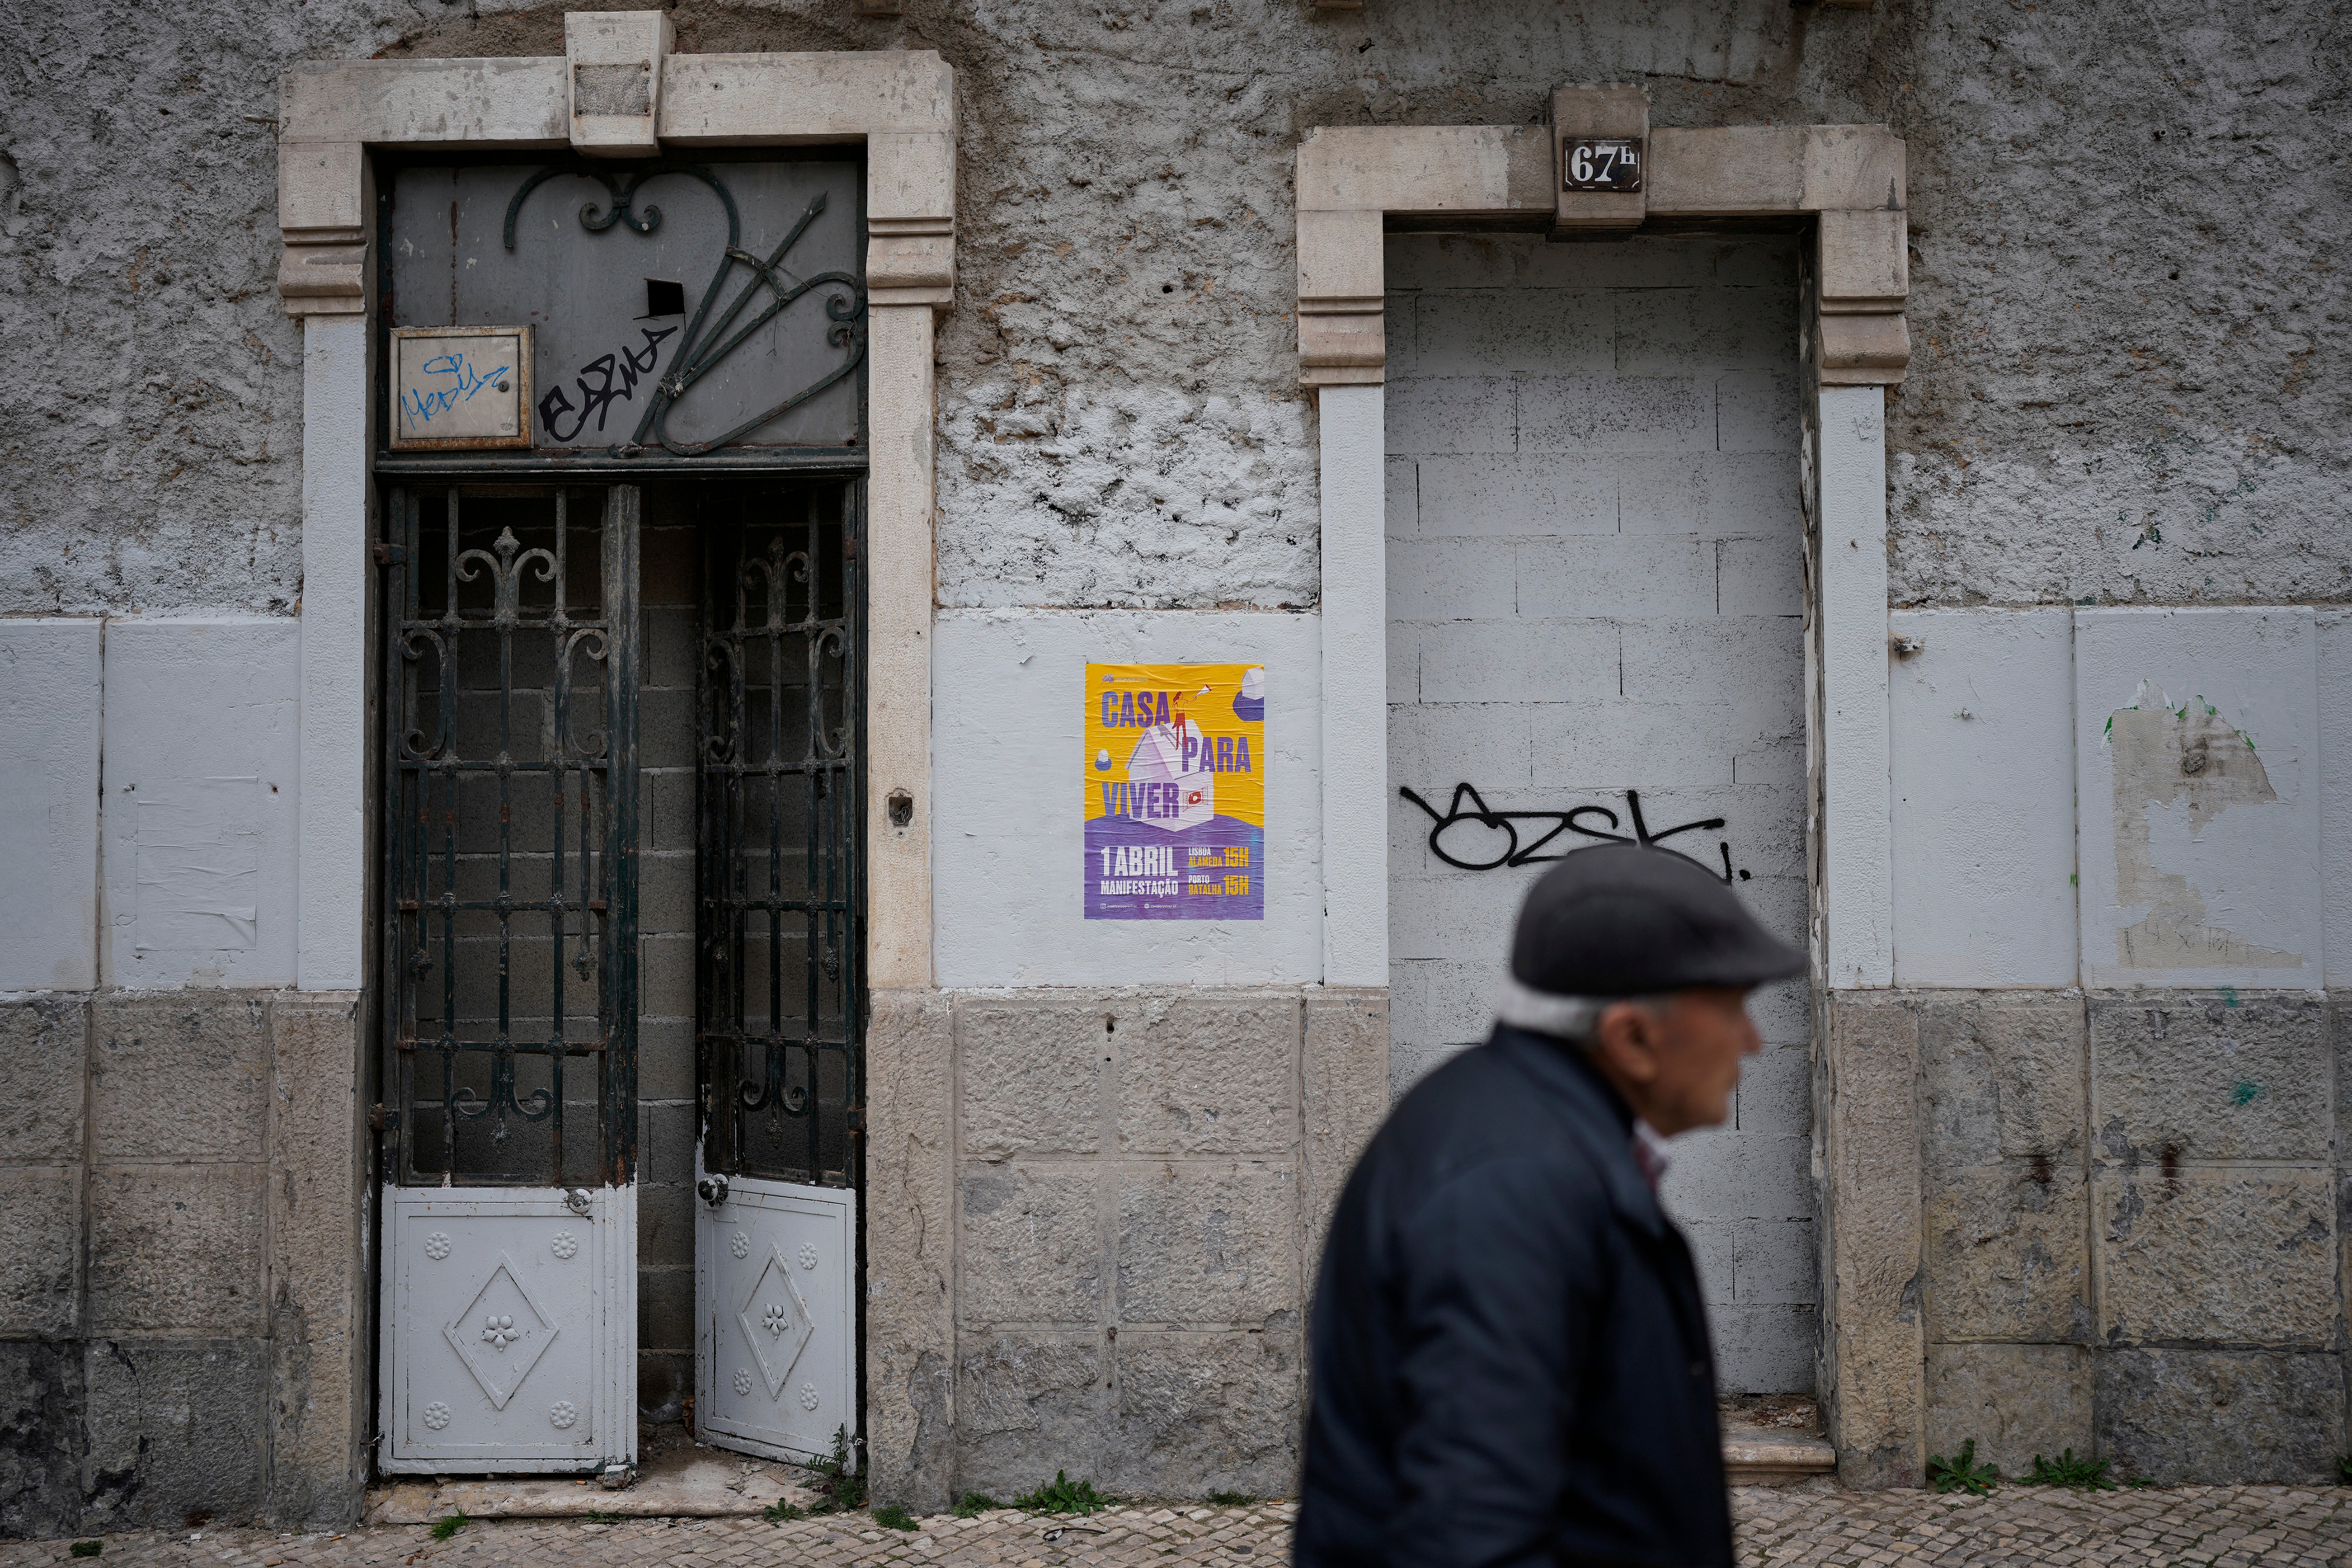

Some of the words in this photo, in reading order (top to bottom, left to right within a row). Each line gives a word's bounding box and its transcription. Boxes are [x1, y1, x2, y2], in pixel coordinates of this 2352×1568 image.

[1102, 691, 1171, 728] CASA
[1182, 737, 1251, 772] PARA
[1102, 783, 1179, 818] VIVER
[1114, 847, 1178, 876] ABRIL
[1188, 847, 1211, 856] LISBOA
[1223, 847, 1249, 867] 15H
[1188, 857, 1223, 867] ALAMEDA
[1101, 878, 1178, 898] MANIFESTAÇÃO
[1188, 875, 1210, 884] PORTO
[1188, 884, 1222, 895] BATALHA
[1223, 875, 1249, 895] 15H
